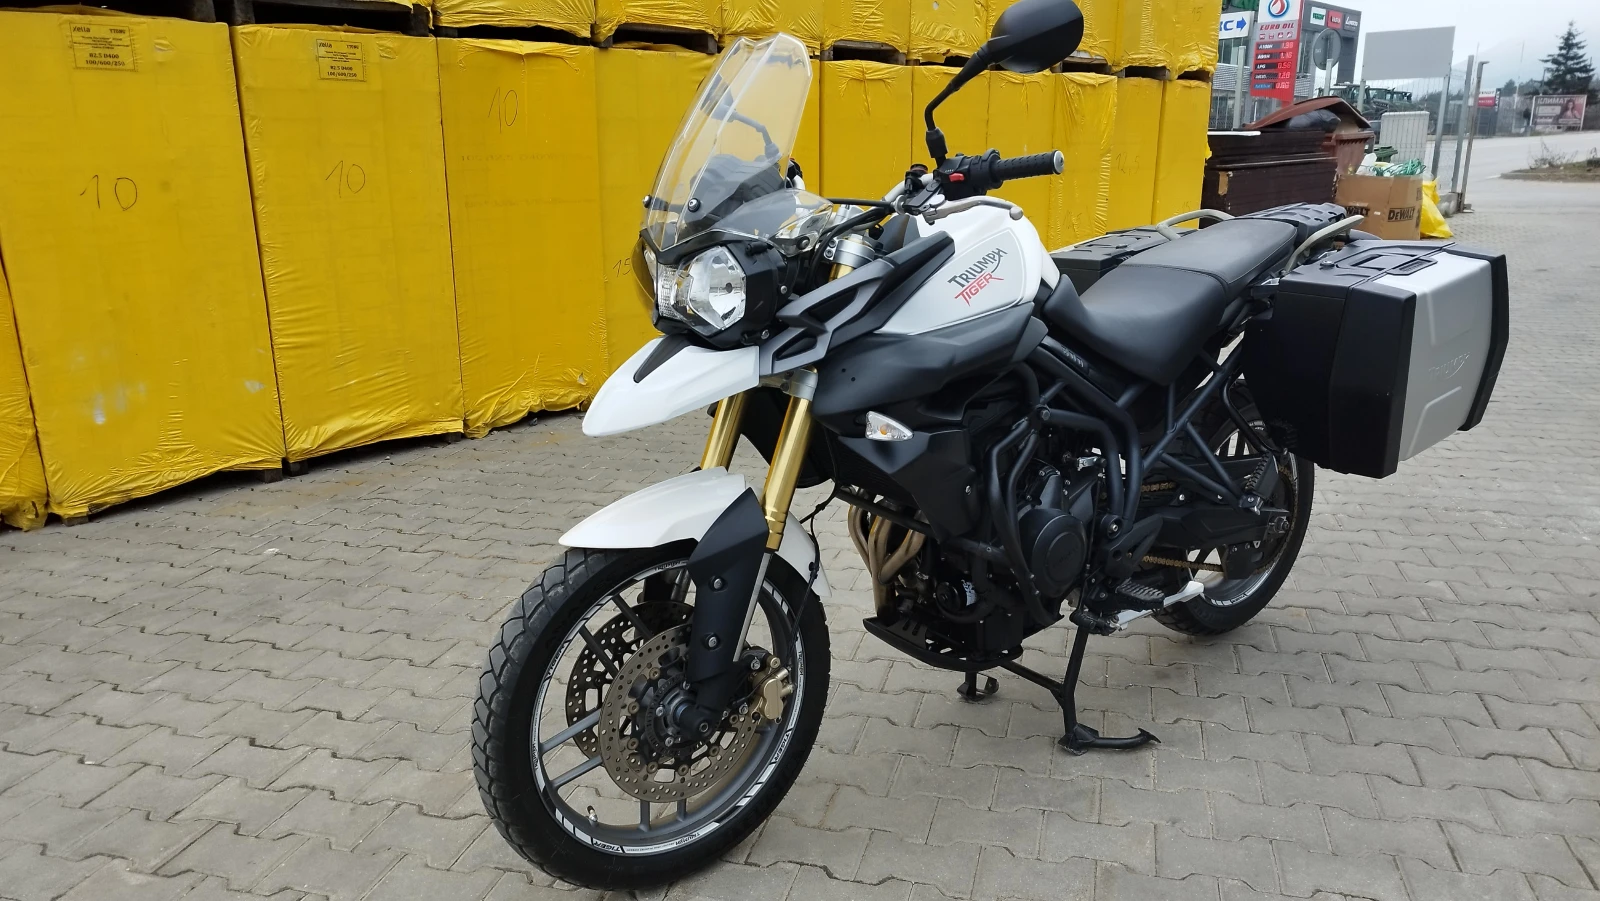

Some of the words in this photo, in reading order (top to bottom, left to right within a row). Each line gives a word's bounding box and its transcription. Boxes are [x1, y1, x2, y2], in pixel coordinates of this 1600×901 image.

[488, 86, 519, 134] 10
[79, 174, 138, 211] 10
[325, 160, 366, 199] 10
[947, 247, 1008, 289] TRIUMPH
[954, 272, 1005, 307] TIGER
[594, 839, 622, 853] TIGER
